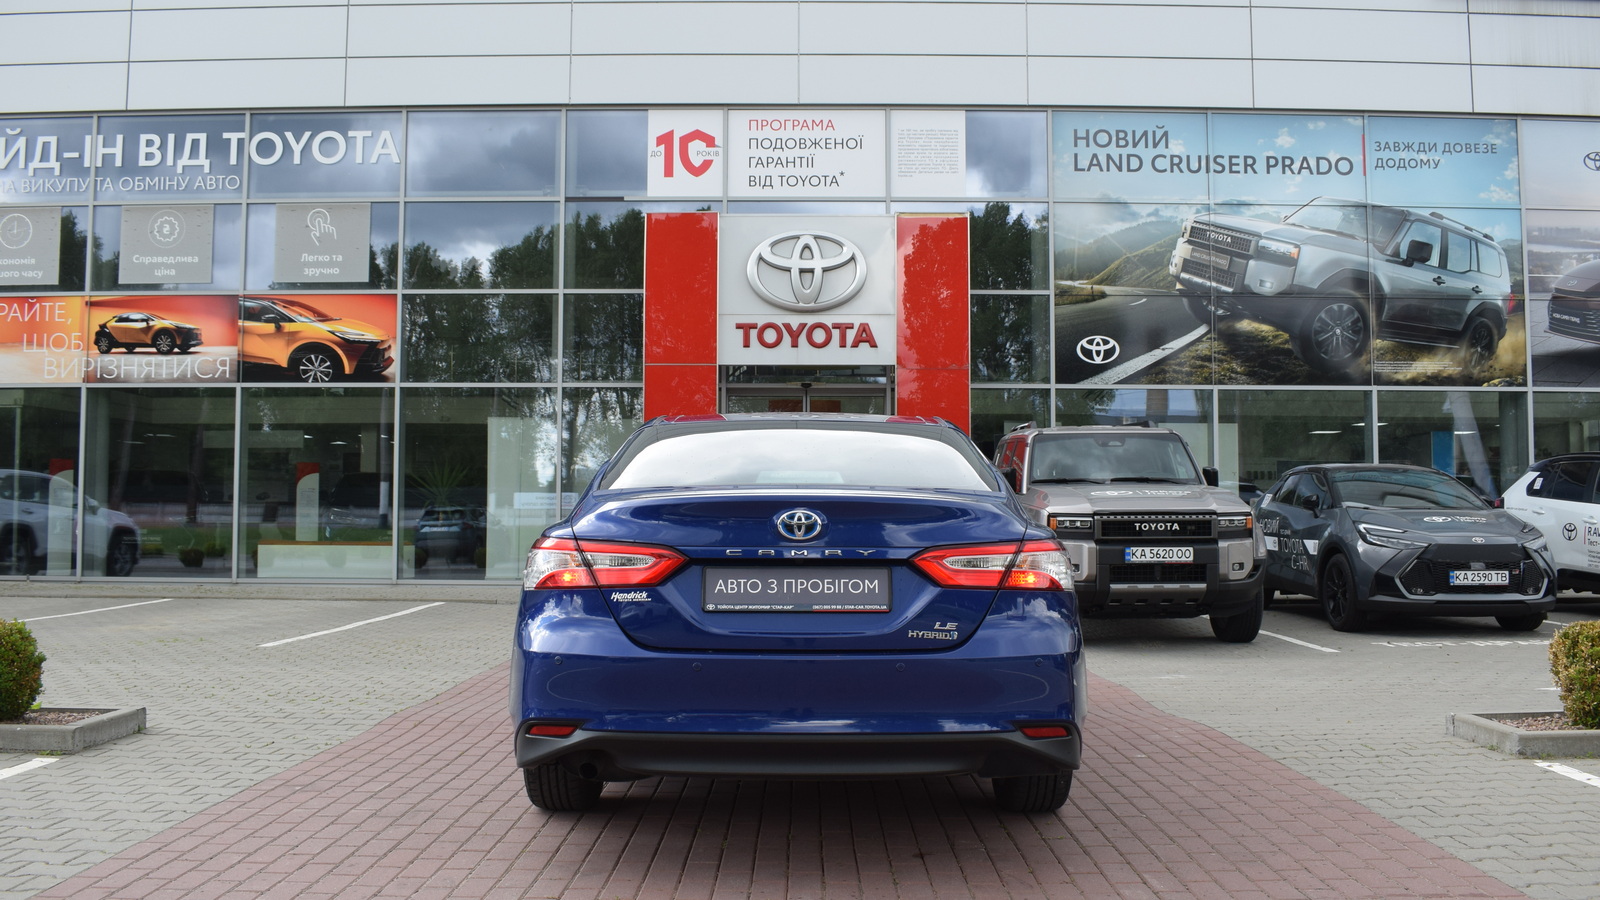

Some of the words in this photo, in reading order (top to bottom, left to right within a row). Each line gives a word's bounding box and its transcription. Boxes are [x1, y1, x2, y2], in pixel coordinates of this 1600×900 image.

[748, 119, 836, 131] ПРОГРАМА
[748, 134, 865, 152] ПОДОВЖЕНОЇ
[1072, 125, 1170, 149] НОВИЙ
[138, 133, 211, 174] ВІД
[222, 130, 401, 166] TOYOTA
[650, 150, 663, 158] ДО
[655, 128, 716, 178] 10
[696, 150, 720, 158] РОКІВ
[1374, 140, 1438, 155] ЗАВЖДИ
[1441, 141, 1498, 156] ДОВЕЗЕ
[748, 153, 815, 169] ГАРАНТІЇ
[1072, 153, 1144, 174] LAND
[1150, 153, 1258, 176] CRUISER
[1265, 155, 1355, 177] PRADO
[1374, 157, 1441, 171] ДОДОМУ
[21, 177, 90, 193] ВИКУПУ
[95, 177, 115, 192] ТА
[119, 176, 190, 192] ОБМІНУ
[194, 175, 241, 190] АВТО
[748, 174, 774, 190] ВІД
[1206, 231, 1232, 243] TOYOTA
[132, 254, 200, 265] Справедлива
[300, 253, 330, 262] Легко
[332, 254, 343, 262] та
[21, 270, 44, 279] часу
[154, 266, 176, 277] ціна
[303, 267, 340, 277] зручно
[735, 322, 879, 349] TOYOTA
[22, 332, 84, 354] ЩОБ
[43, 356, 231, 379] ВИРІЗНЯТИСЯ
[1134, 522, 1180, 531] TOYOTA
[1280, 537, 1305, 554] TOYOTA
[725, 549, 877, 557] CAMRY
[1131, 549, 1147, 559] KA
[1149, 548, 1175, 559] 5620
[1291, 554, 1310, 571] C-HR
[1455, 572, 1469, 582] KA
[1470, 572, 1493, 582] 2590
[714, 578, 762, 594] АВТО
[767, 578, 778, 594] З
[783, 578, 880, 594] ПРОБІГОМ
[610, 590, 649, 602] Hendrick
[933, 621, 959, 630] LE
[908, 630, 950, 640] HYBRID
